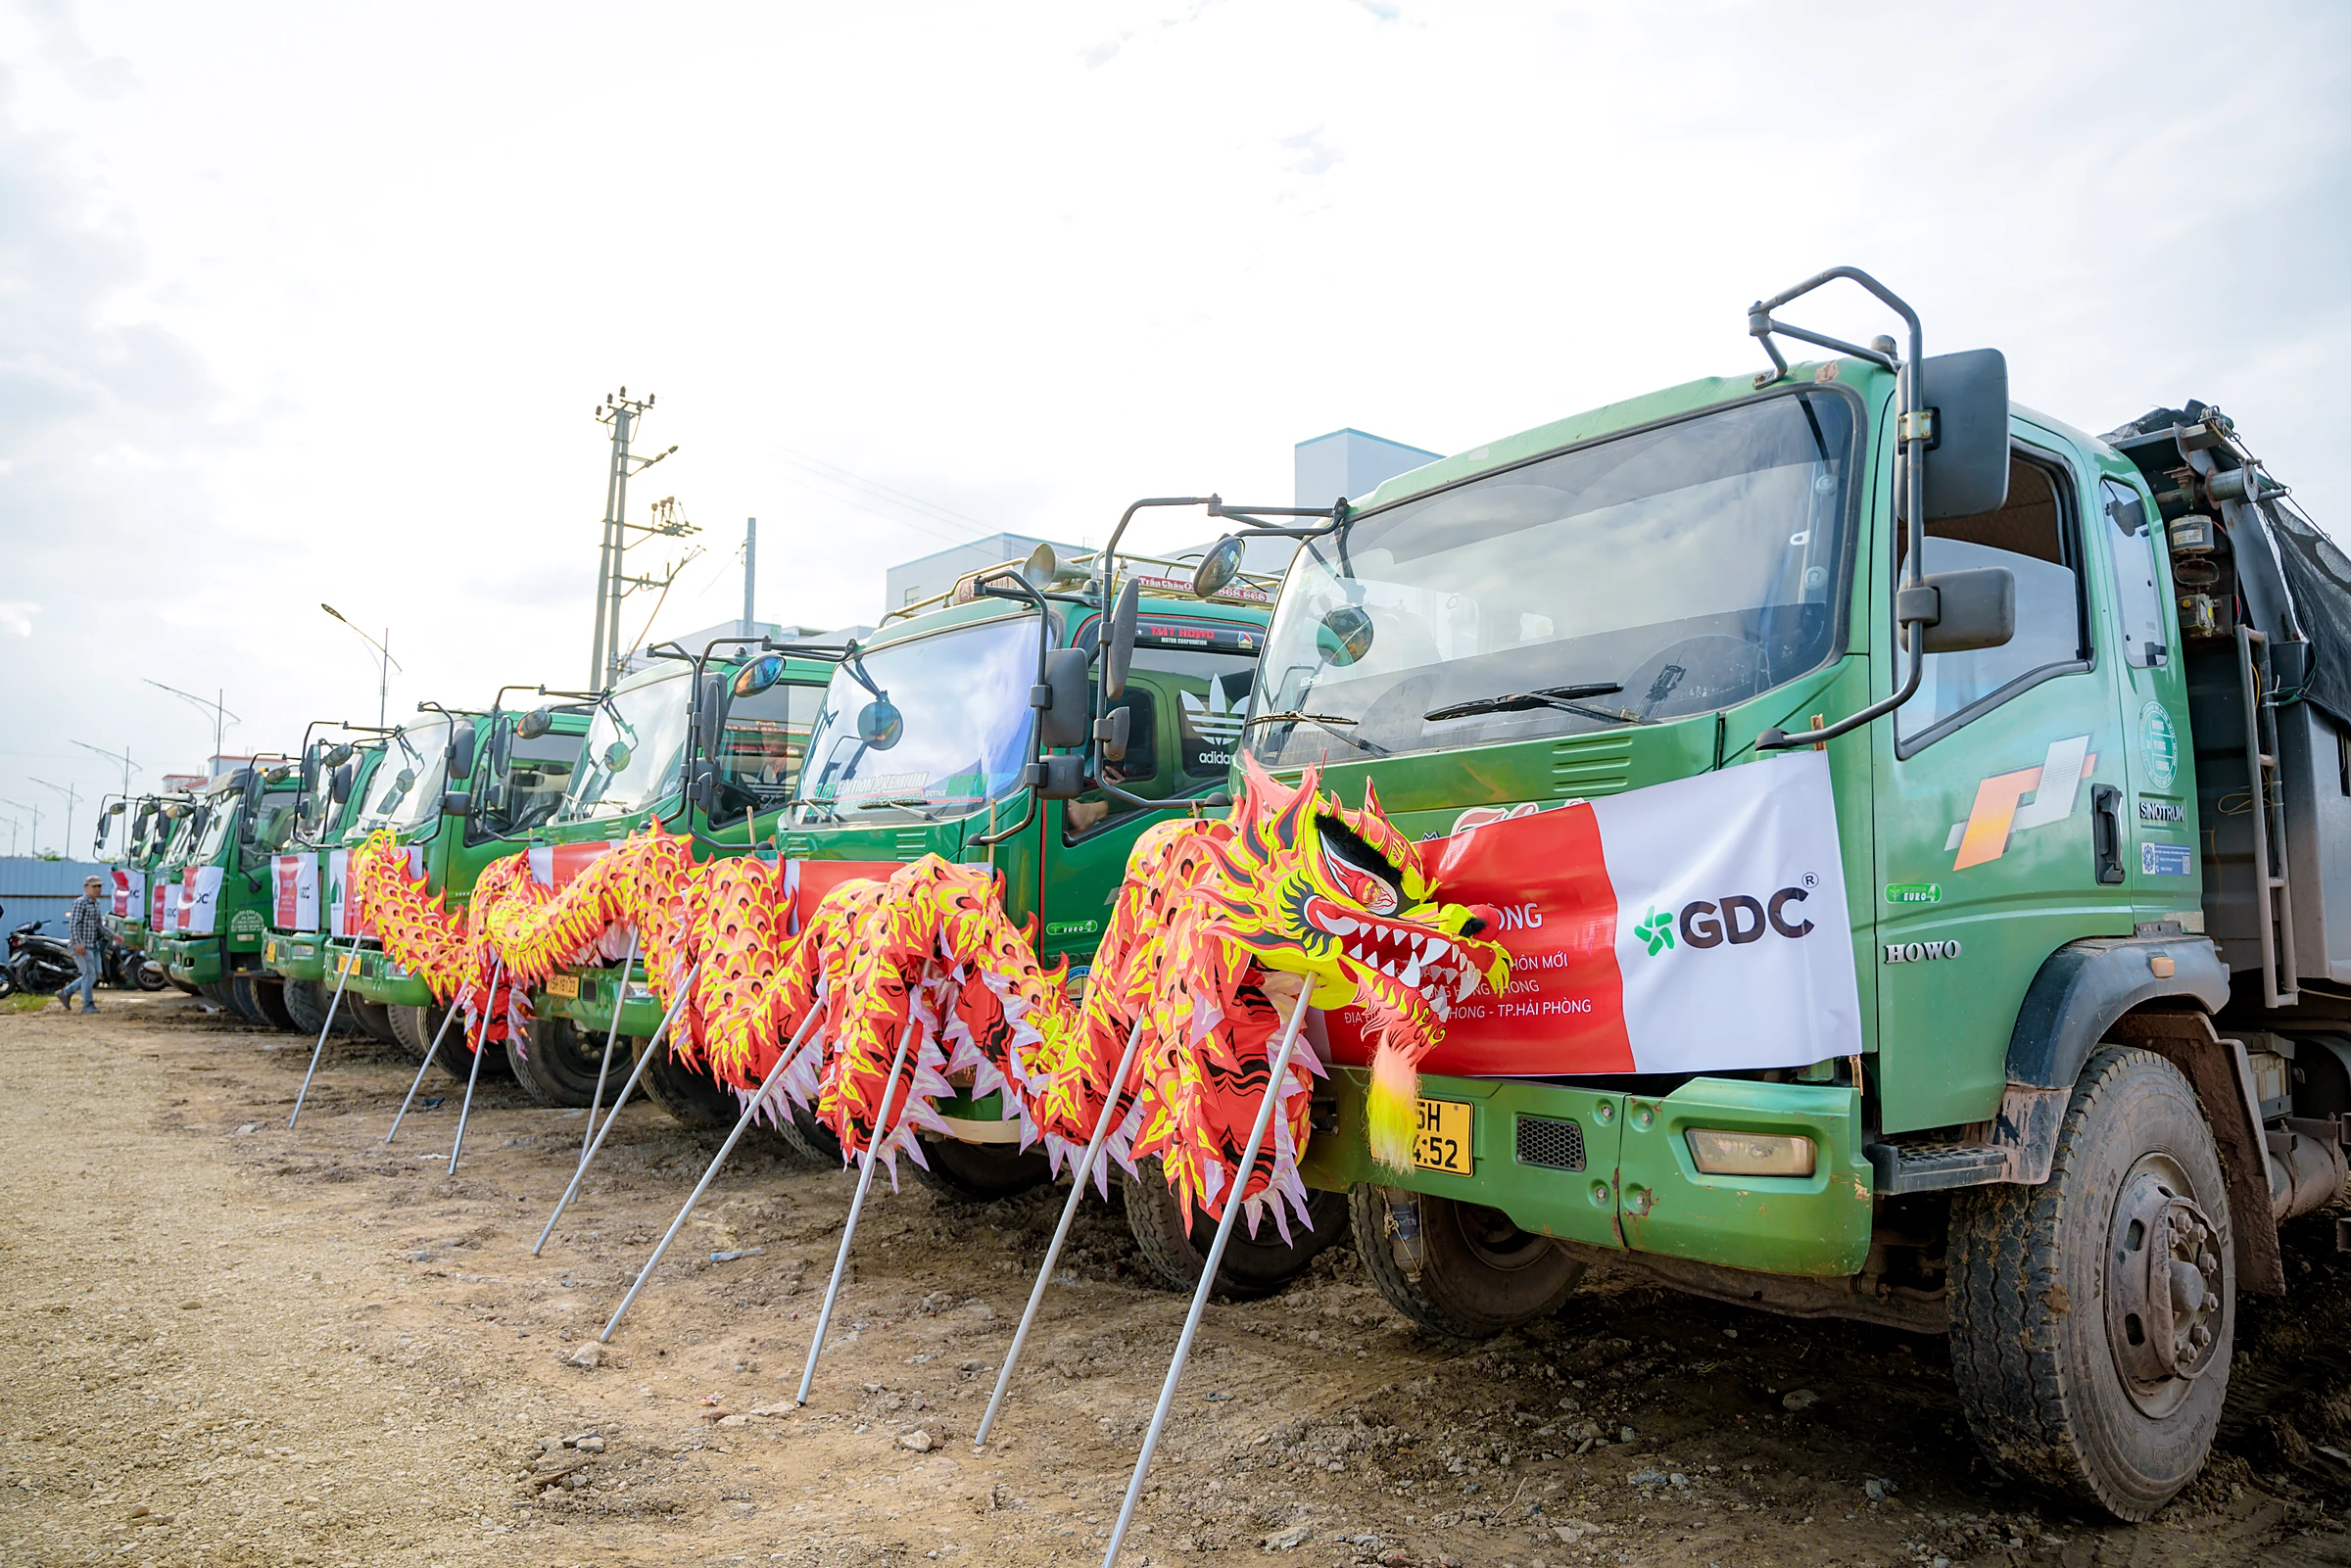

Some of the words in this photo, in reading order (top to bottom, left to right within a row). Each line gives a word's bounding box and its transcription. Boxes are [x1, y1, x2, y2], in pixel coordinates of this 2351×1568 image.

[1199, 750, 1231, 765] adida
[1679, 886, 1815, 949] GDC
[1047, 951, 1096, 968] HOW
[1509, 953, 1539, 972] HÔN
[1541, 950, 1568, 970] MỚI
[1884, 939, 1962, 964] HOWO
[1449, 1005, 1486, 1020] HONG
[1542, 996, 1592, 1016] PHÒNG
[1416, 1101, 1441, 1132] 5H
